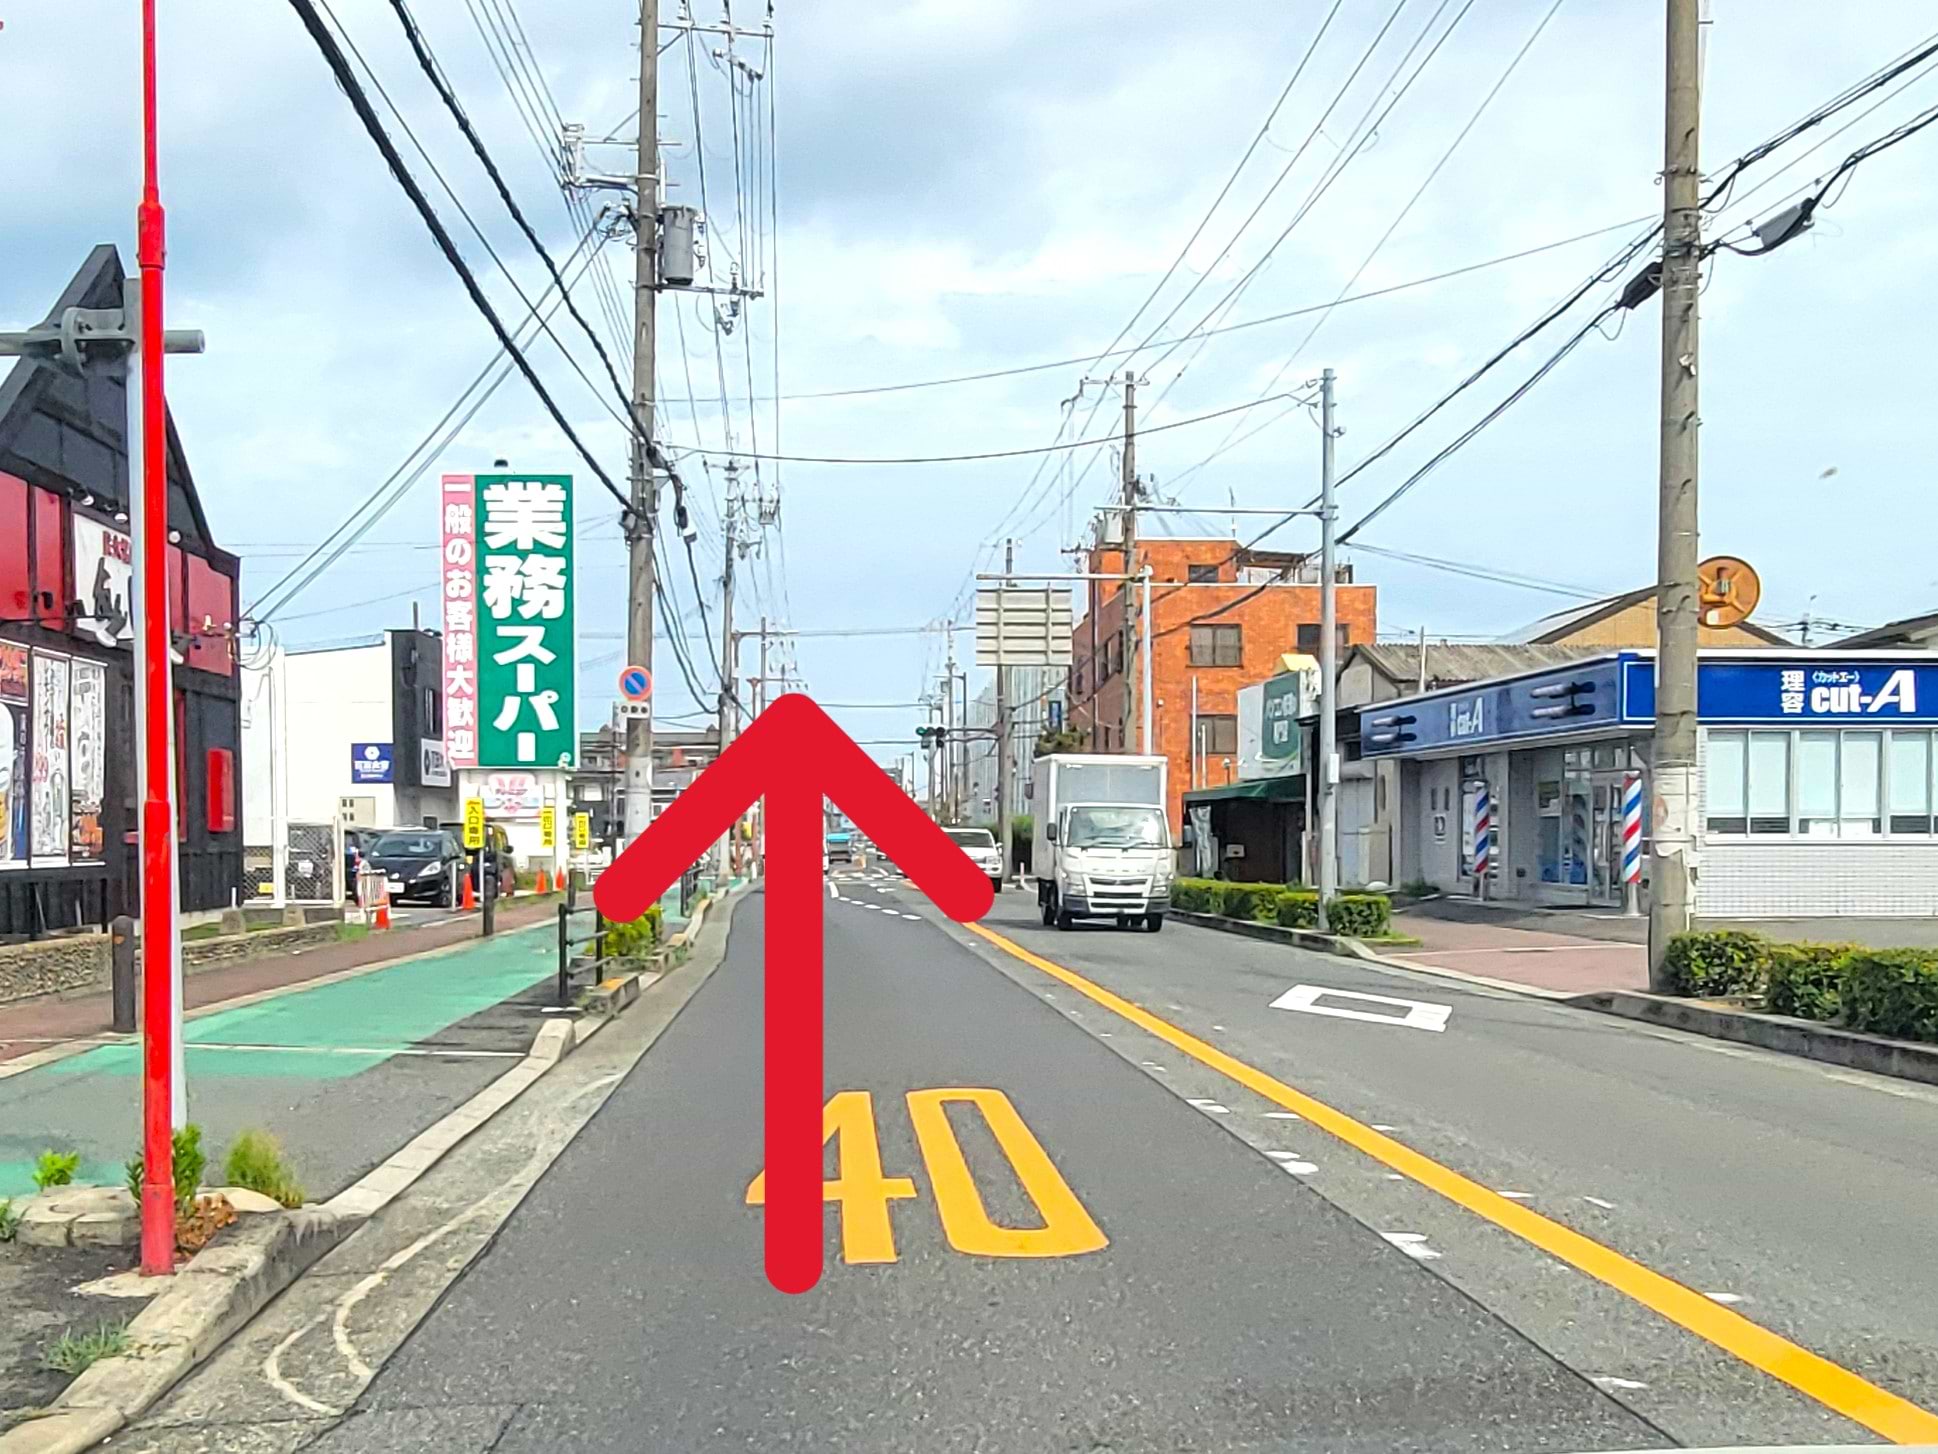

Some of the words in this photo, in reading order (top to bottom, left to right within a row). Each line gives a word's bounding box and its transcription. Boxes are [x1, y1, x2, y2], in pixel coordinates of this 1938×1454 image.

[444, 483, 474, 760] 一般のお客様大歓迎
[483, 481, 566, 761] 業務スーパー
[1781, 670, 1805, 713] 理容
[1811, 670, 1916, 713] cut-A
[746, 1088, 1109, 1263] 40
